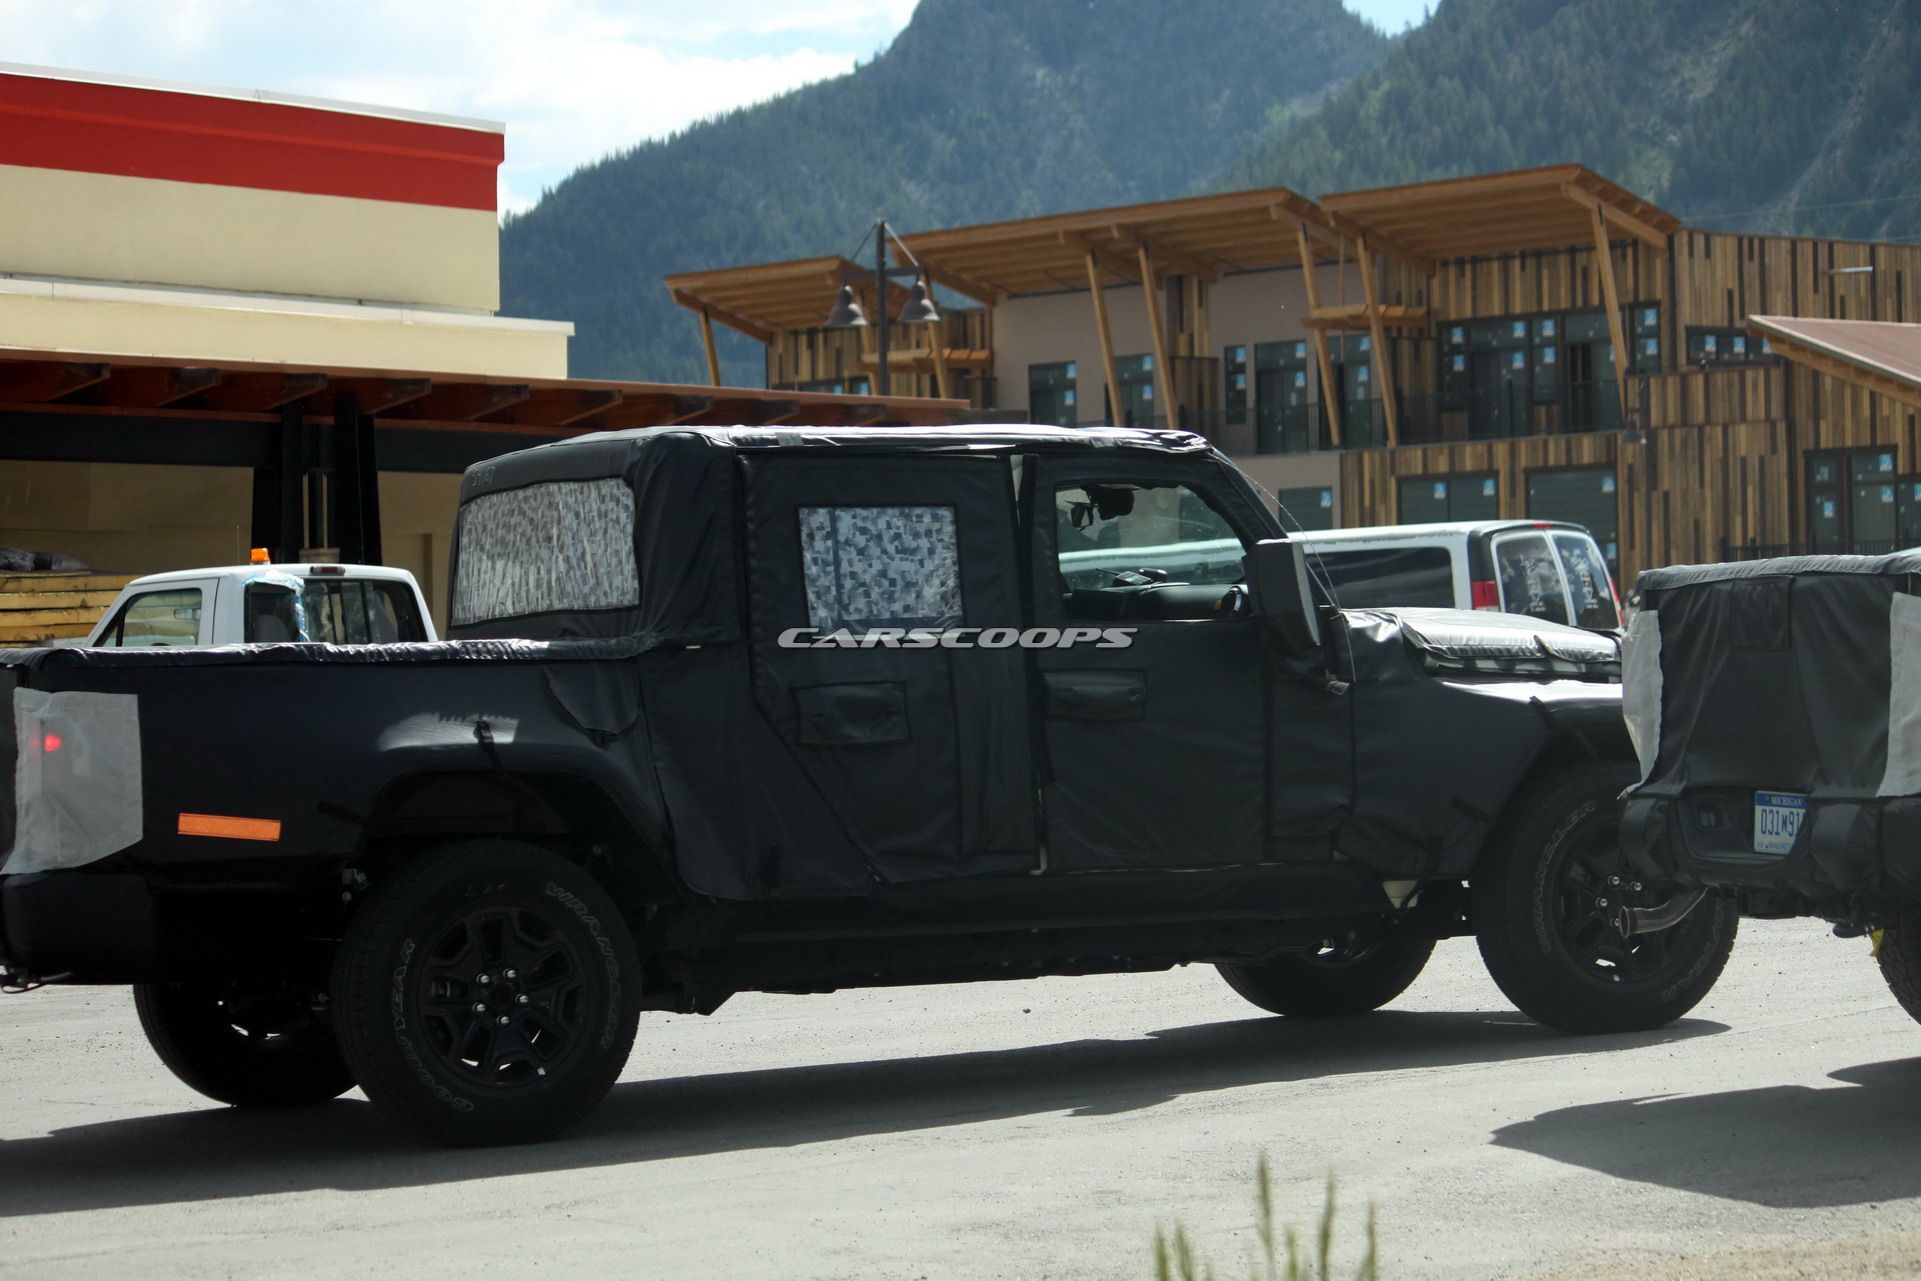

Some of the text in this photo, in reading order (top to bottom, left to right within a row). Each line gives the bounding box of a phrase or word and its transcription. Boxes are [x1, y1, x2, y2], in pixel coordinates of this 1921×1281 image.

[1770, 796, 1803, 807] MICHIGAN
[1760, 808, 1801, 837] 031M91
[544, 881, 624, 1050] WRANGLER
